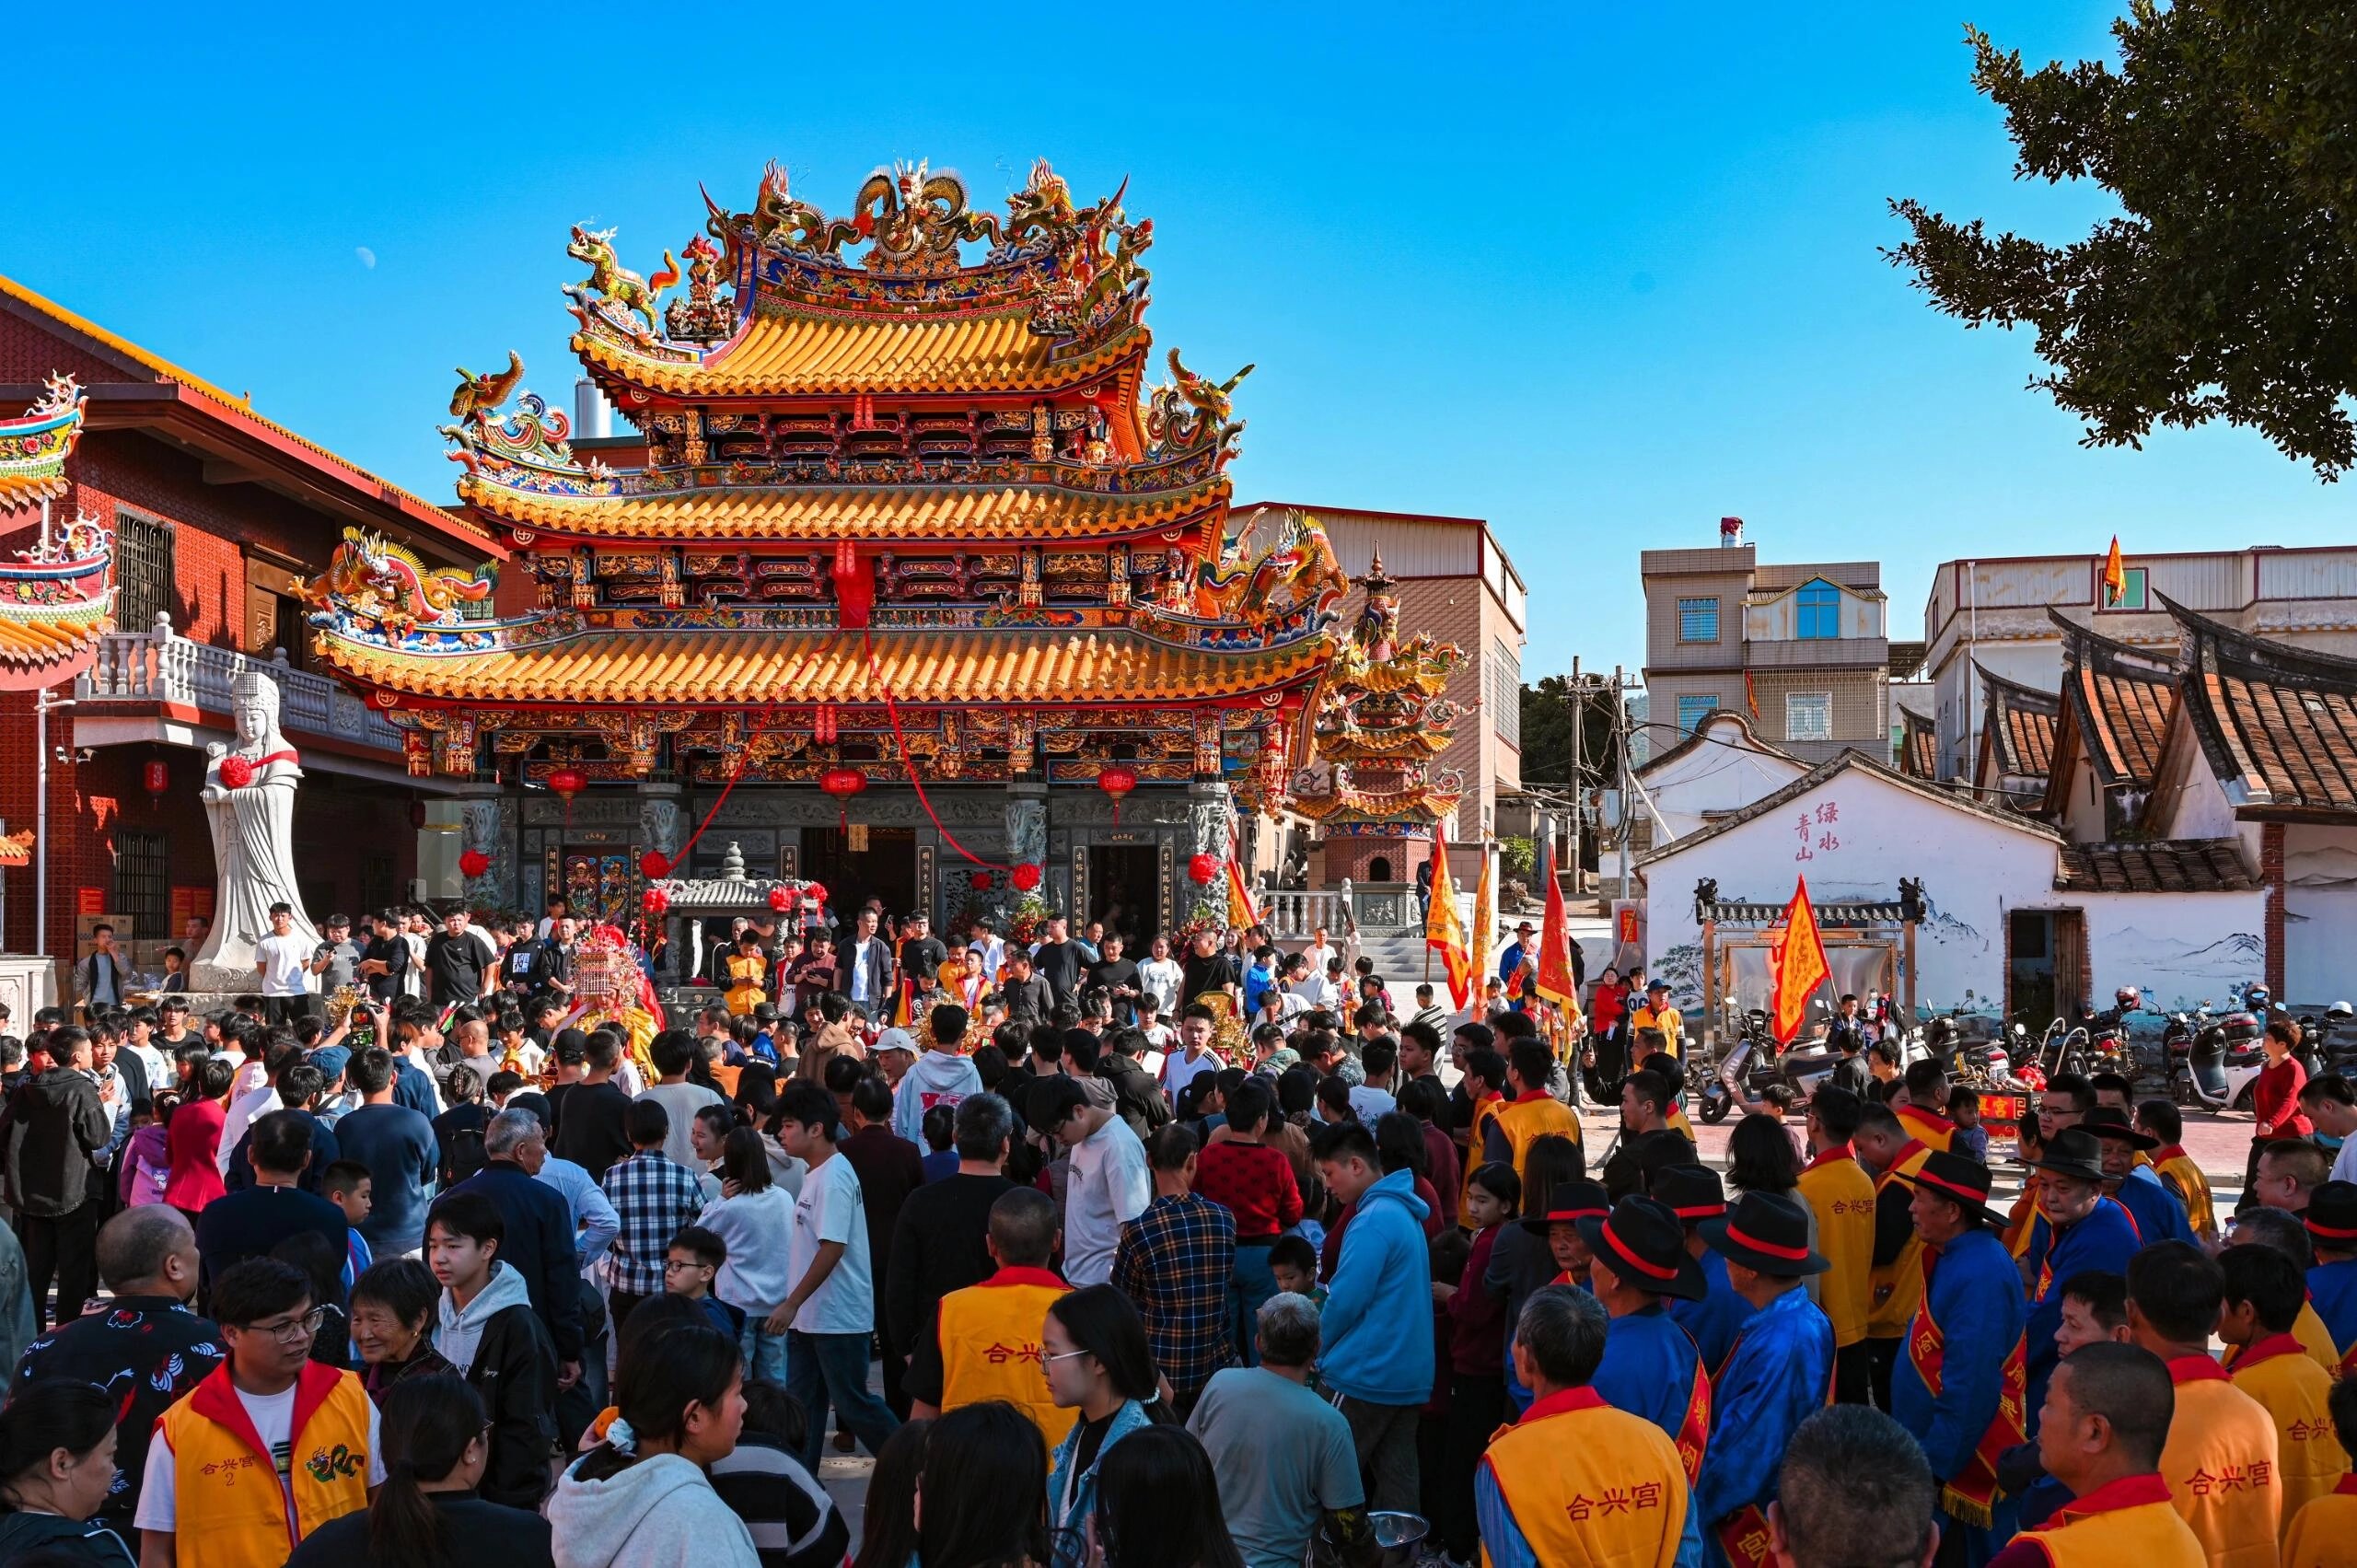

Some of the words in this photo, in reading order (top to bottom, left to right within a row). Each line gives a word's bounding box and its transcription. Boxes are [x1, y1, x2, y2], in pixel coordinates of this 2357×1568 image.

[1794, 813, 1813, 861] 青山
[1830, 1199, 1874, 1214] 合兴宫
[2287, 1417, 2337, 1440] 合兴
[200, 1455, 255, 1475] 合兴宫
[225, 1473, 235, 1486] 2
[2184, 1459, 2271, 1495] 合兴宫
[1566, 1481, 1661, 1521] 合兴宫
